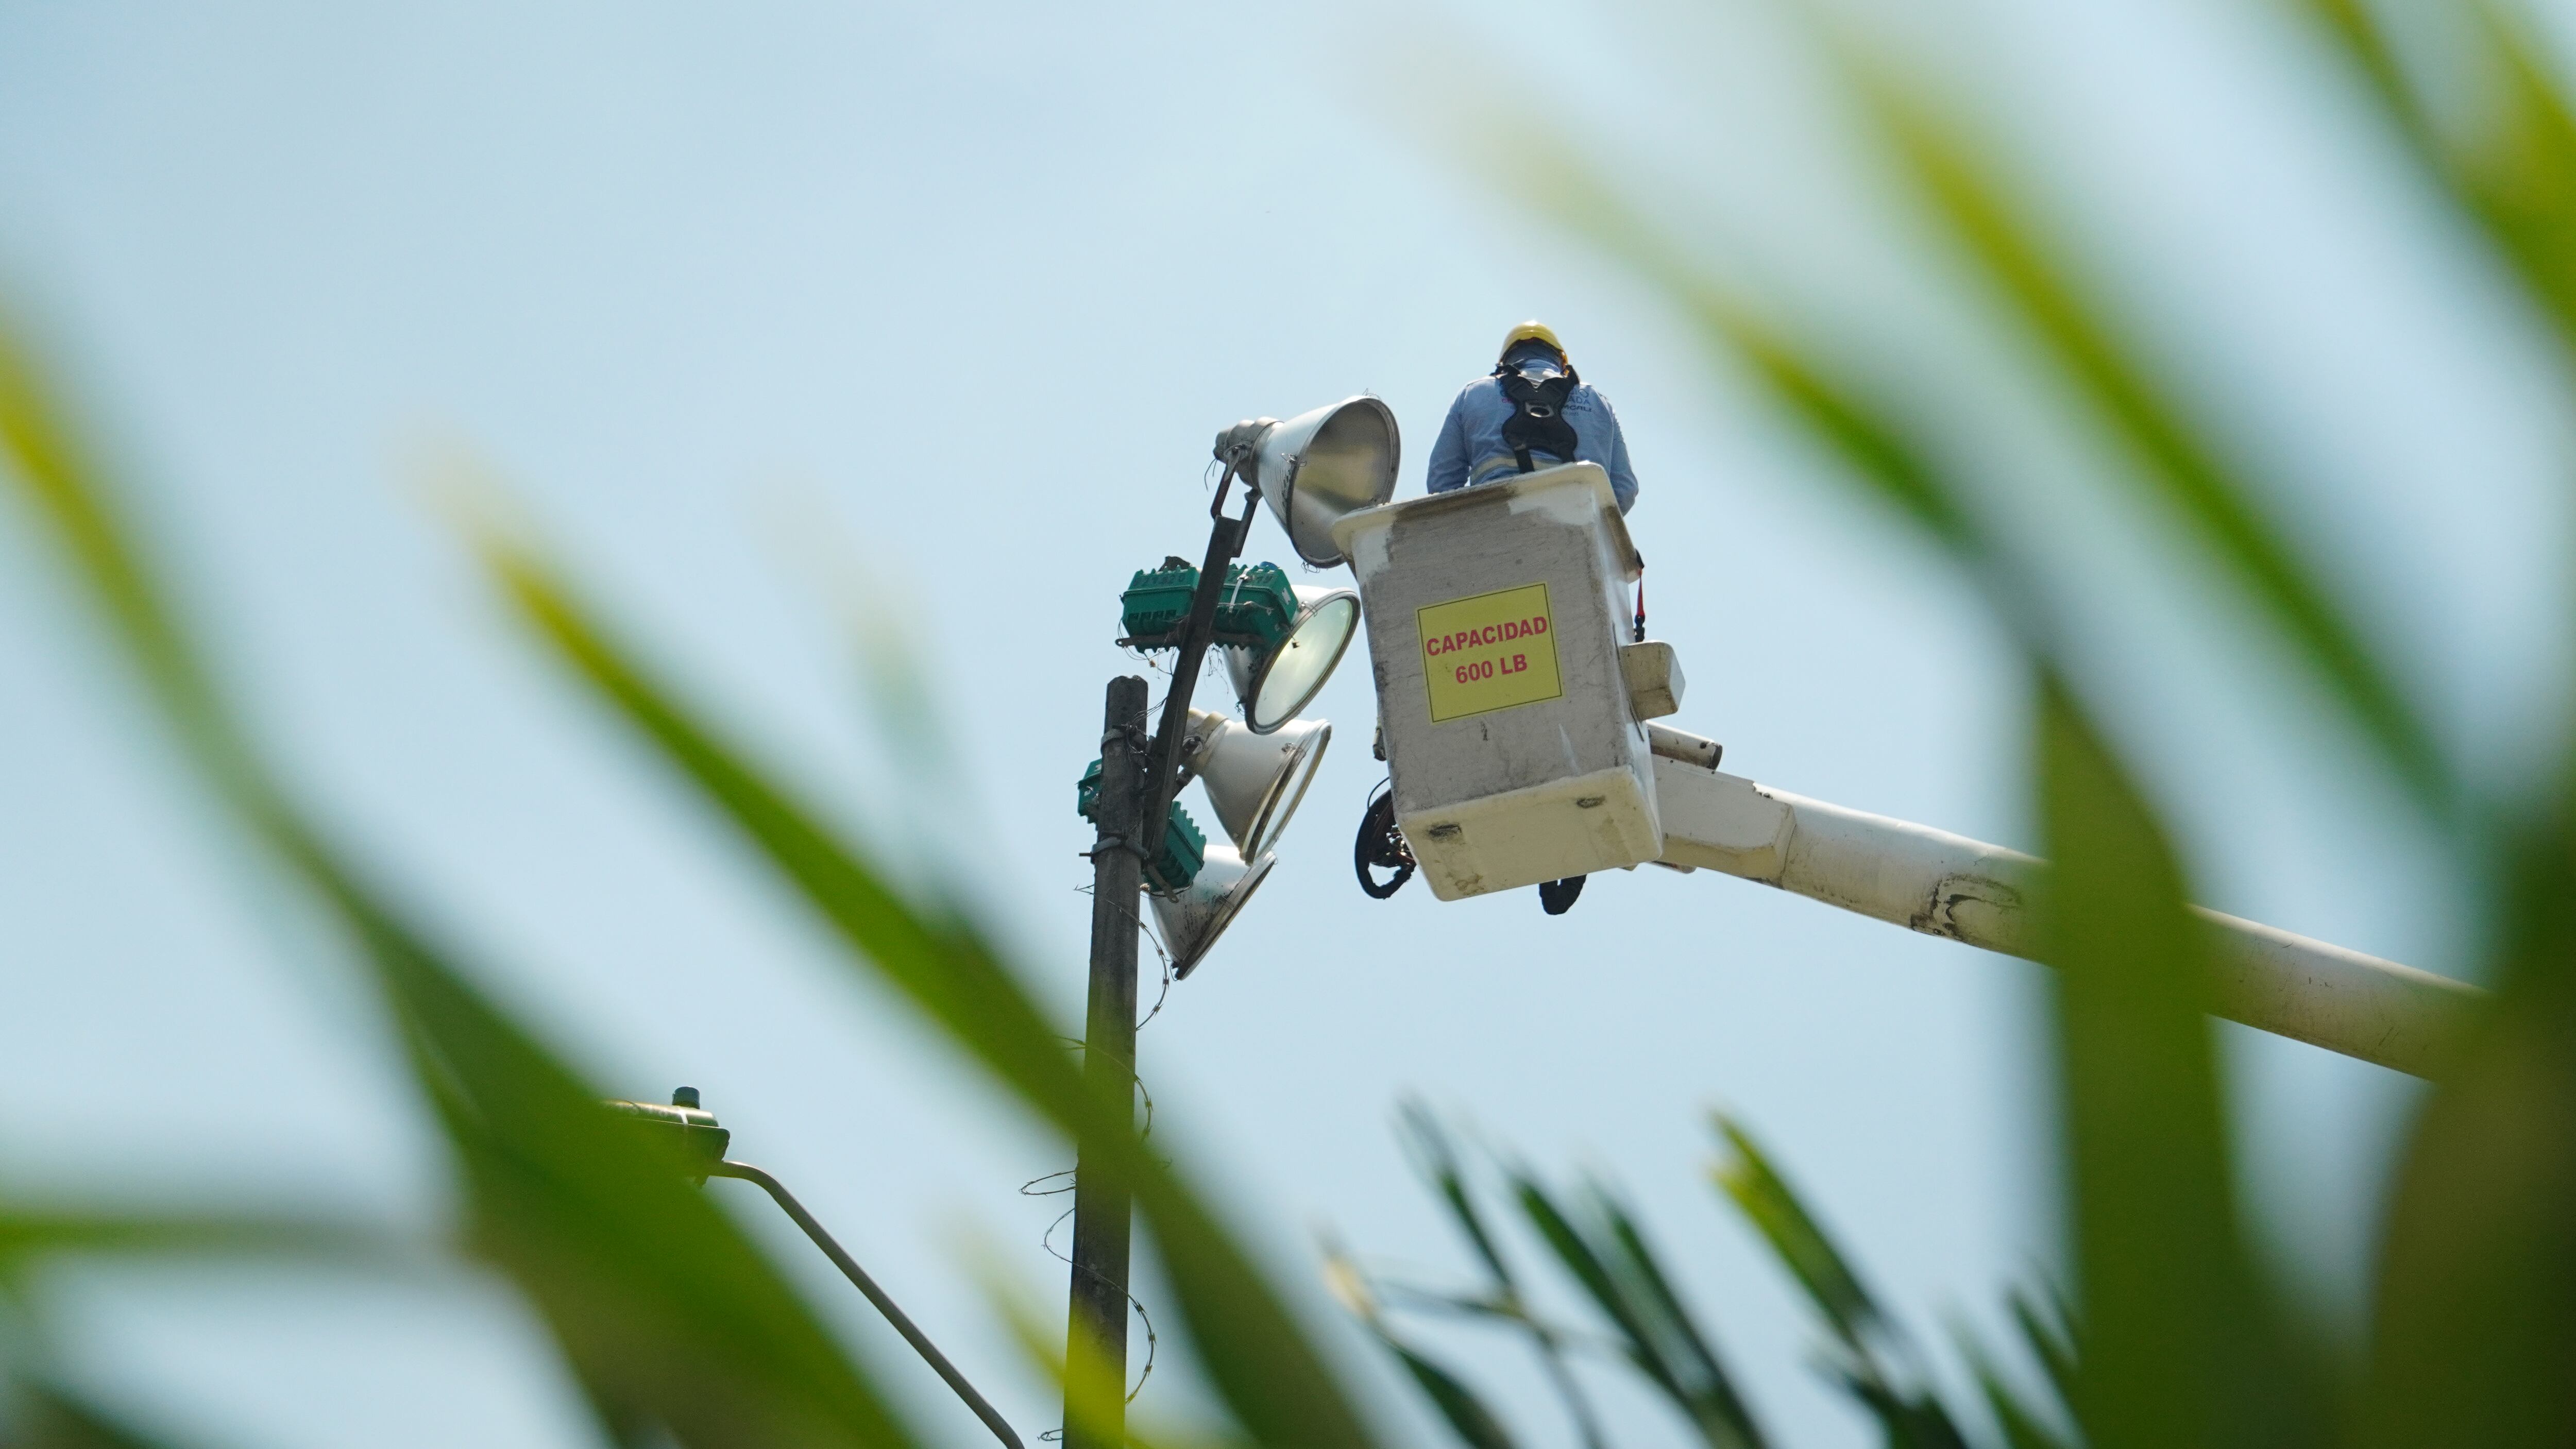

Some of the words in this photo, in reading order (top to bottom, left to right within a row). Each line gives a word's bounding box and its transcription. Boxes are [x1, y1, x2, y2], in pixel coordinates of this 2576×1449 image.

[1426, 616, 1548, 656] CAPACIDAD
[1455, 661, 1494, 684] 600
[1500, 654, 1528, 675] LB
